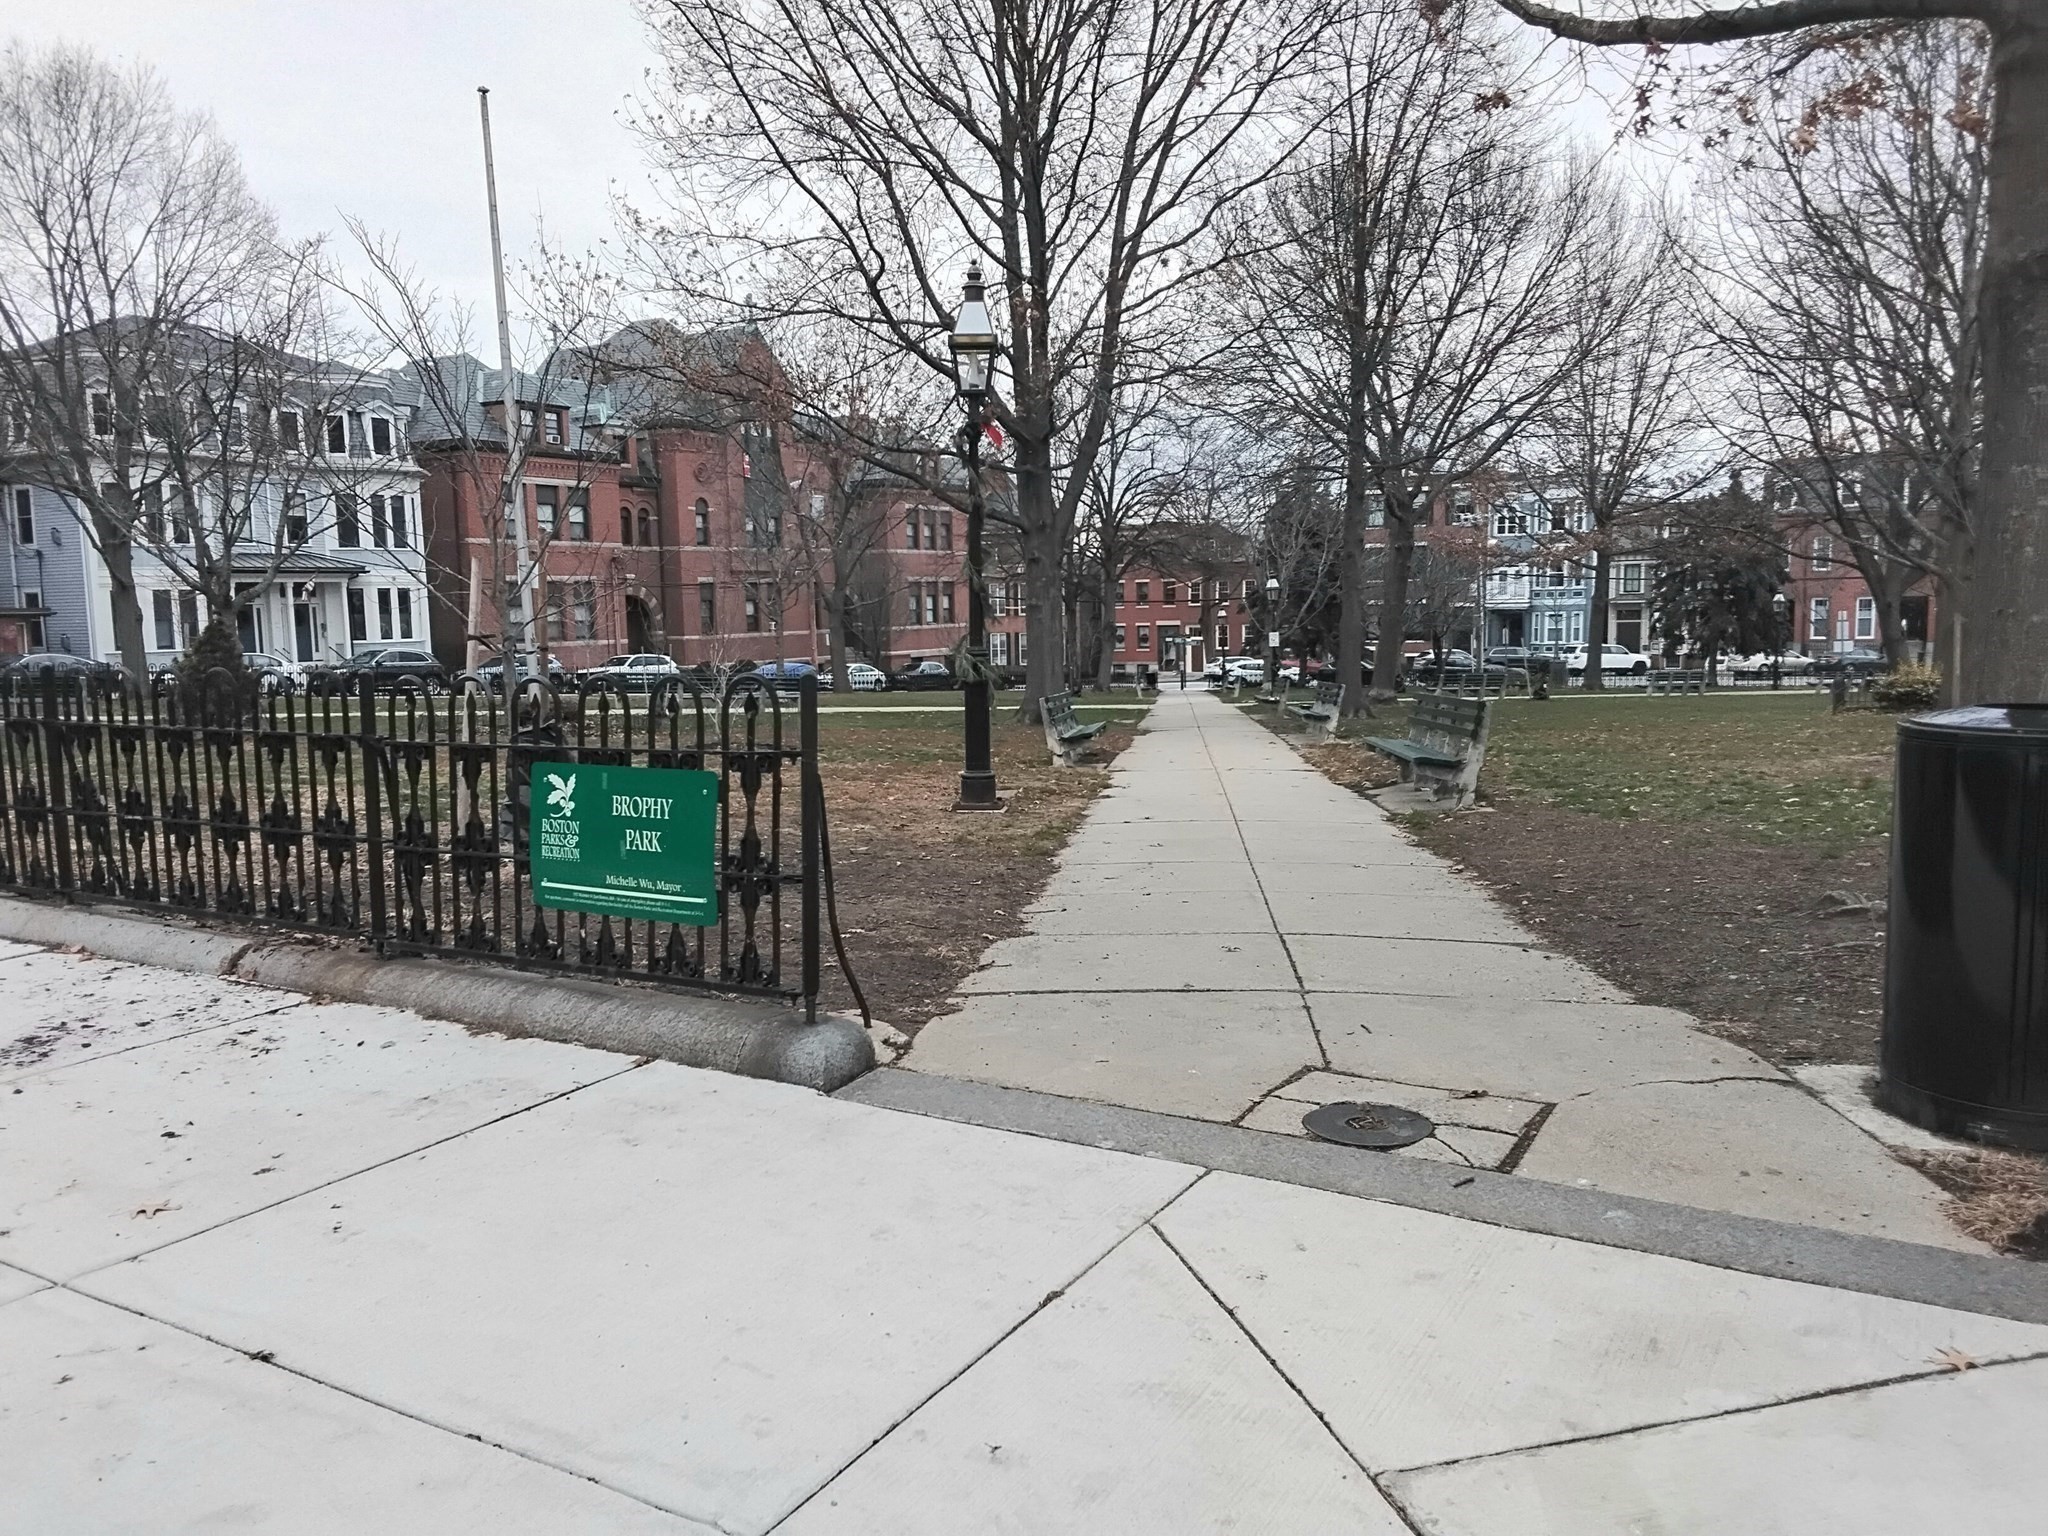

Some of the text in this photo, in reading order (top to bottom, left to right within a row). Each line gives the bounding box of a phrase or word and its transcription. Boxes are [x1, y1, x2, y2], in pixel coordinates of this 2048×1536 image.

[611, 795, 673, 819] BROPHY
[541, 818, 580, 834] BOSTON
[625, 829, 662, 852] PARK
[541, 845, 580, 859] RECREATION
[605, 875, 682, 893] Michelle Wu, Mayor
